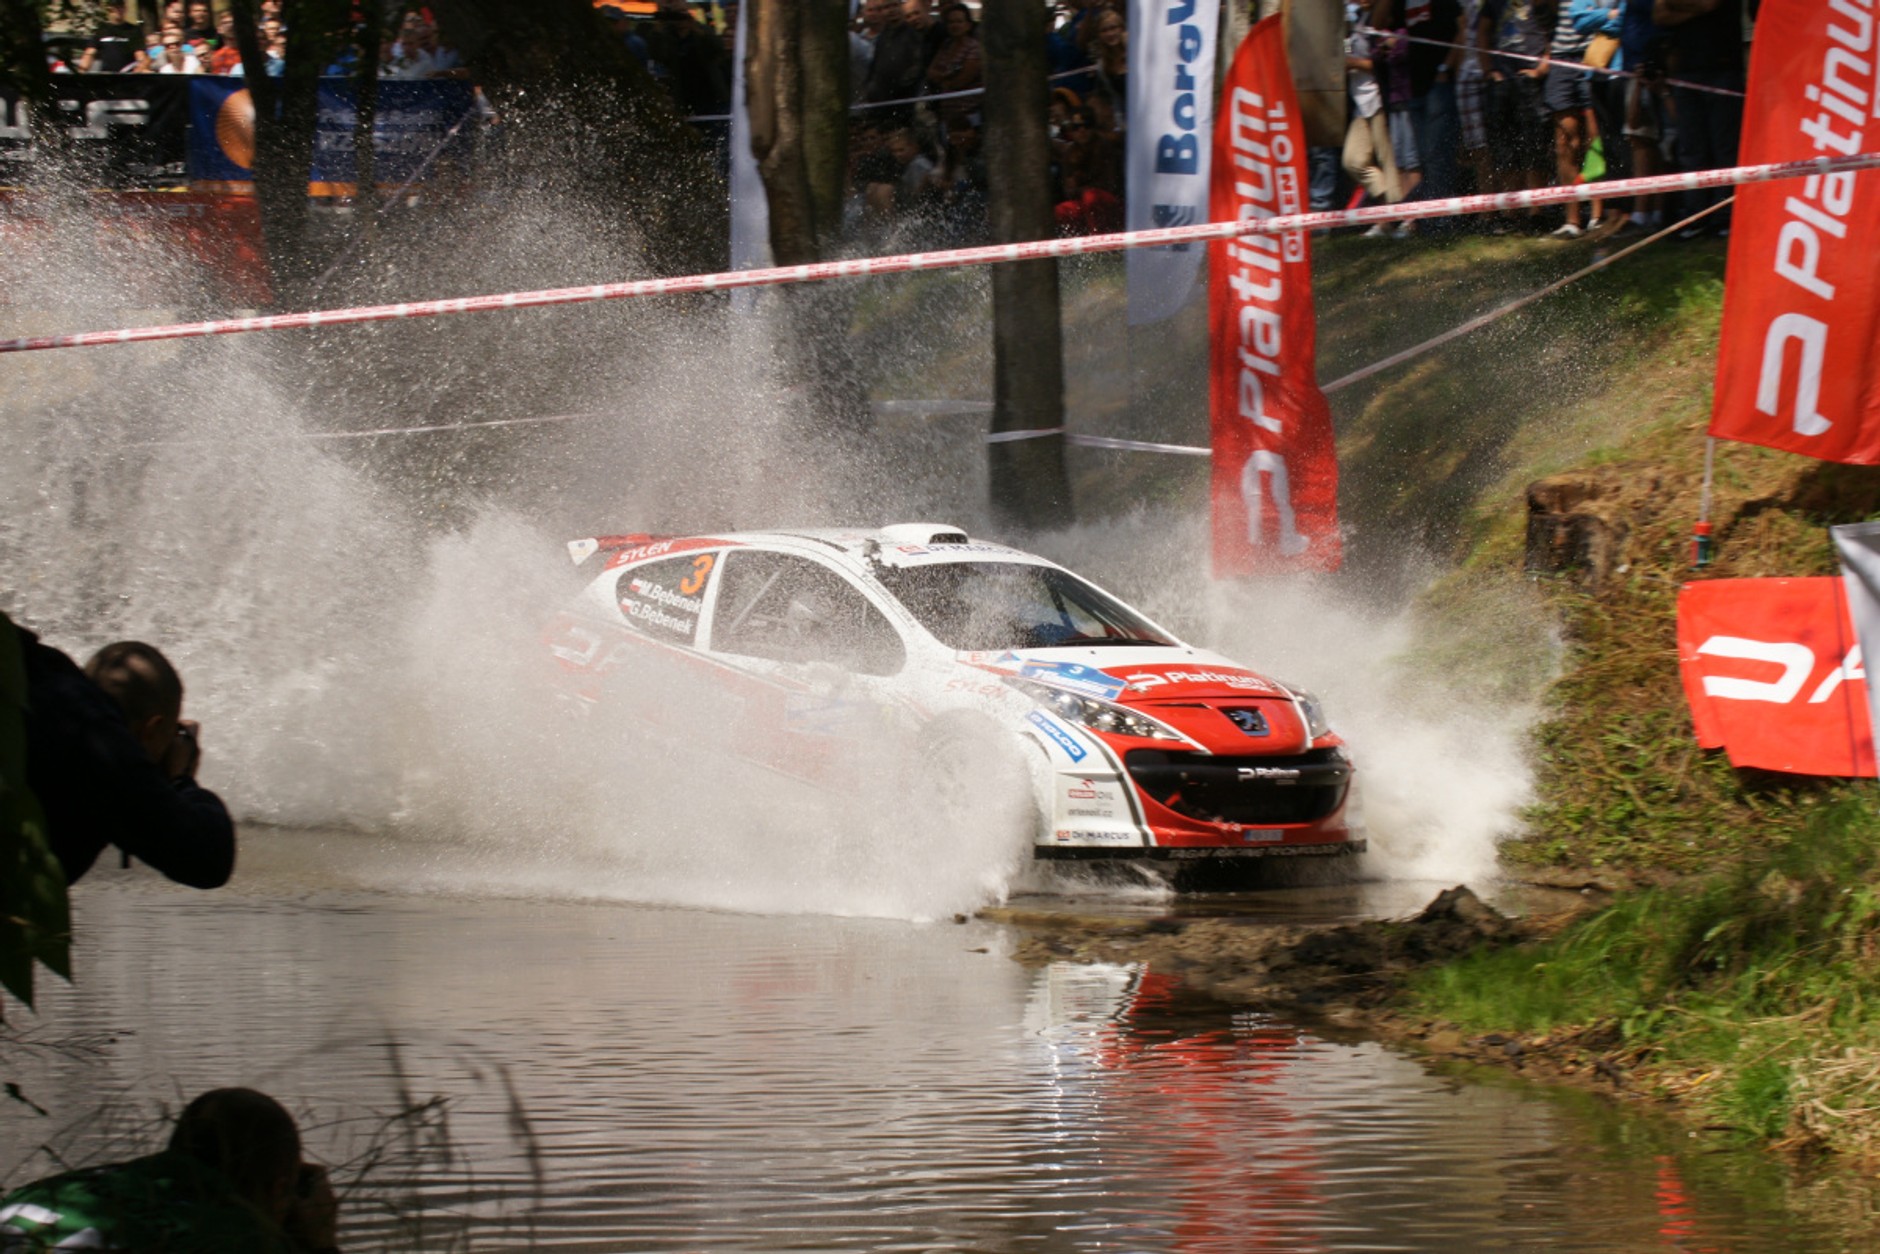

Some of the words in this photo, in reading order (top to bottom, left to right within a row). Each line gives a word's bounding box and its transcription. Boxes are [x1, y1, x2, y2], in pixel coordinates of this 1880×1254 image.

[1267, 101, 1293, 163] OIL
[1774, 0, 1873, 300] Platinu
[1227, 87, 1283, 433] Platinum
[617, 541, 674, 565] SYLEN
[681, 554, 714, 596] 3
[1164, 671, 1267, 687] Platinum
